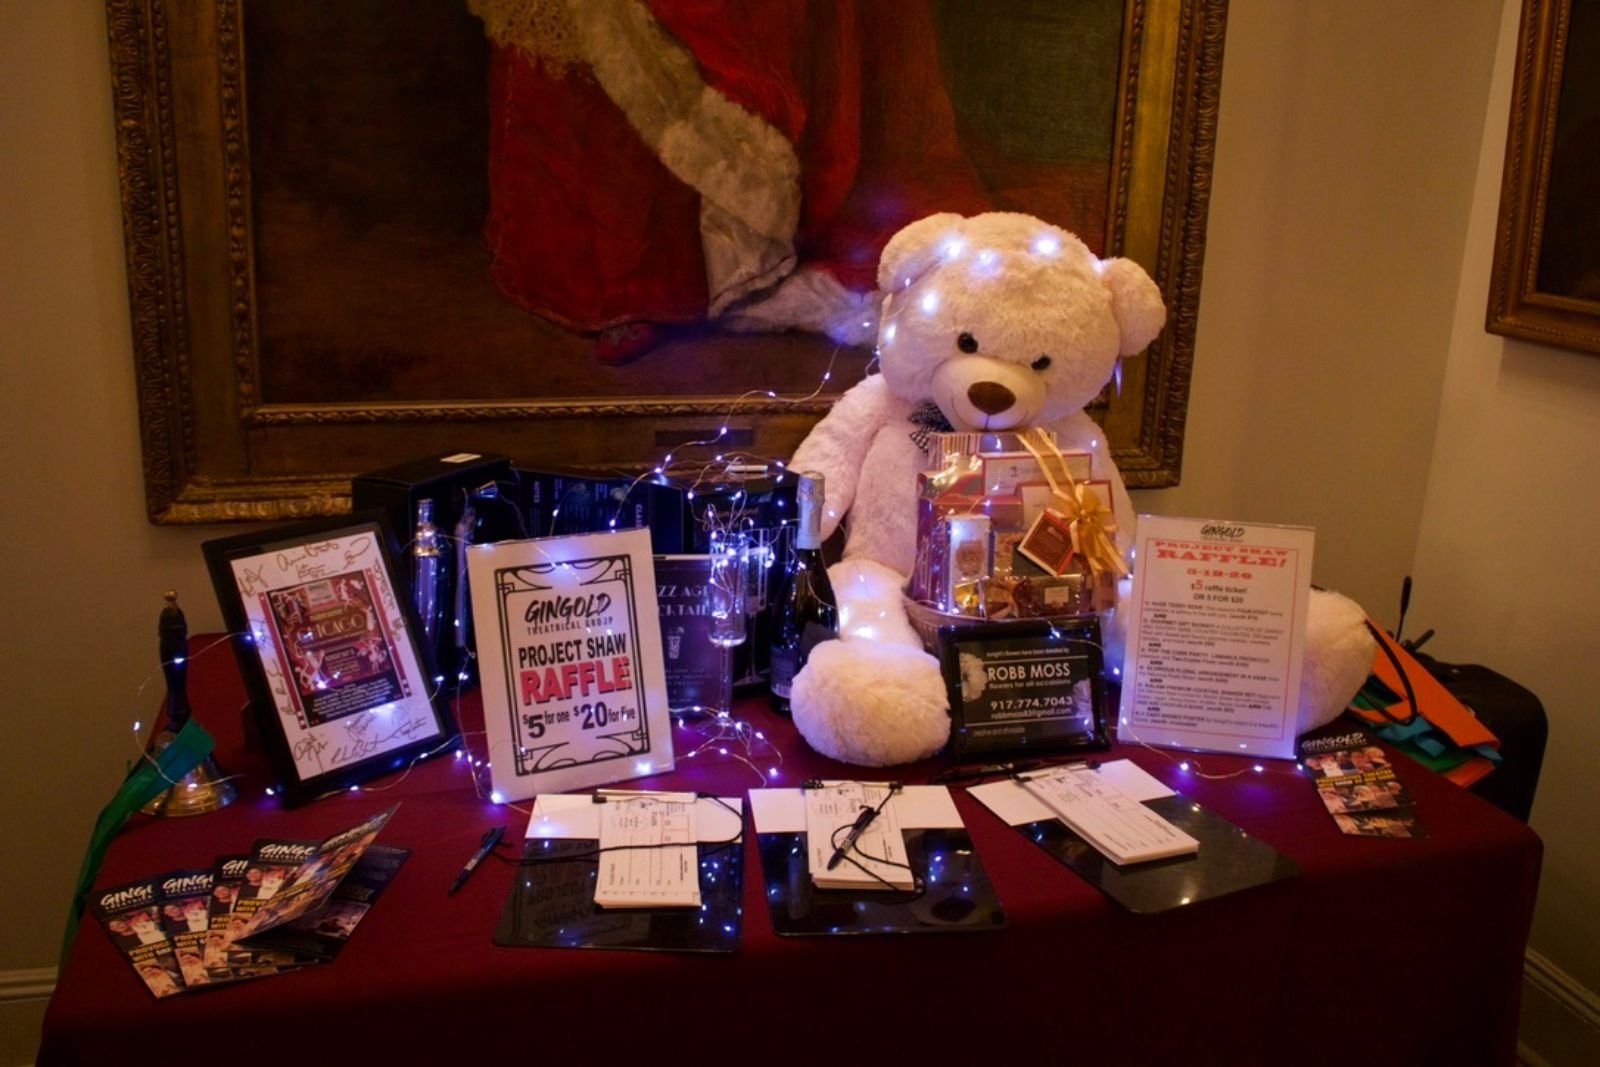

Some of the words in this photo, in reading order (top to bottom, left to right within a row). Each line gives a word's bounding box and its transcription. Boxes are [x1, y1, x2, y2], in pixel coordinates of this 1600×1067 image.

[1200, 525, 1245, 538] GINGOLD
[1155, 542, 1234, 552] PROJECT
[1156, 550, 1287, 568] RAFFLE!
[1231, 596, 1244, 604] $20
[524, 594, 611, 625] GINGOLD
[659, 604, 708, 616] CKTAIL
[528, 620, 582, 636] THEATRICAL
[518, 639, 582, 668] PROJECT
[586, 632, 626, 659] SHAW
[988, 665, 1026, 681] ROBB
[1030, 662, 1070, 678] MOSS
[520, 656, 632, 706] RAFFLE
[990, 696, 1073, 710] 917.774.7043
[522, 714, 546, 738] $5
[544, 710, 554, 724] for
[556, 711, 570, 723] one
[574, 701, 608, 730] $20
[608, 708, 620, 722] for
[621, 706, 636, 722] Fve
[260, 844, 316, 859] GINGO
[163, 875, 214, 894] GING
[100, 885, 152, 908] GING
